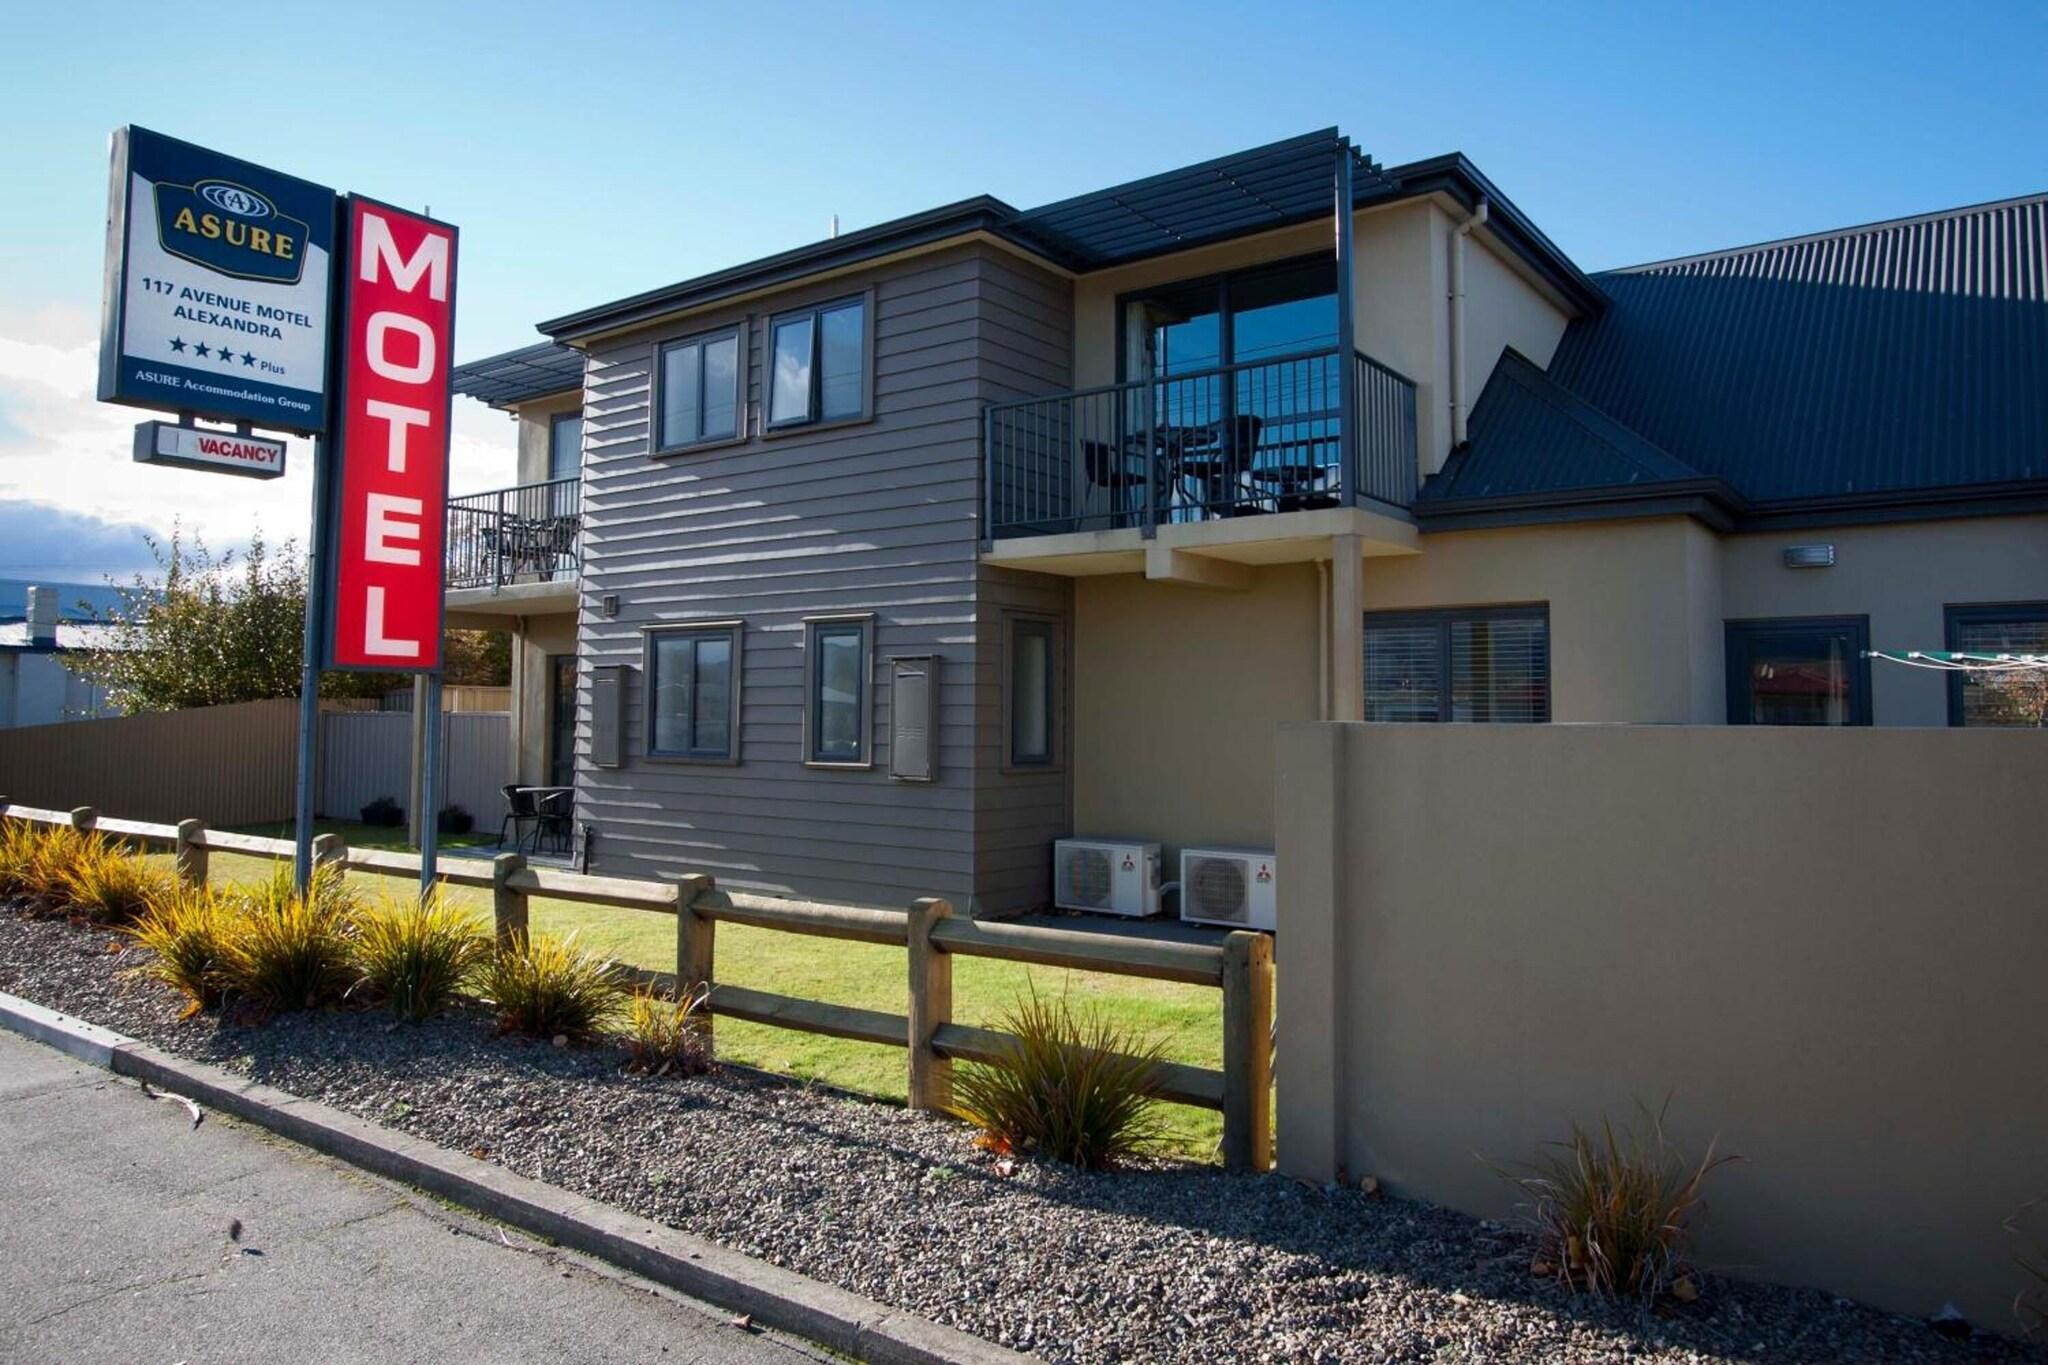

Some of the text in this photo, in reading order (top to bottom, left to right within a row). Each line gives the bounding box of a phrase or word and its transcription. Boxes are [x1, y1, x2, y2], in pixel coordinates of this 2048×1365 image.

[174, 207, 294, 259] ASURE
[142, 277, 312, 328] 117 AVENUE MOTEL
[174, 305, 282, 341] ALEXANDRA
[260, 360, 285, 375] Plus
[135, 370, 311, 412] ASURE Accommodation Group
[198, 437, 278, 463] VACANCY
[360, 212, 449, 657] MOTEL
